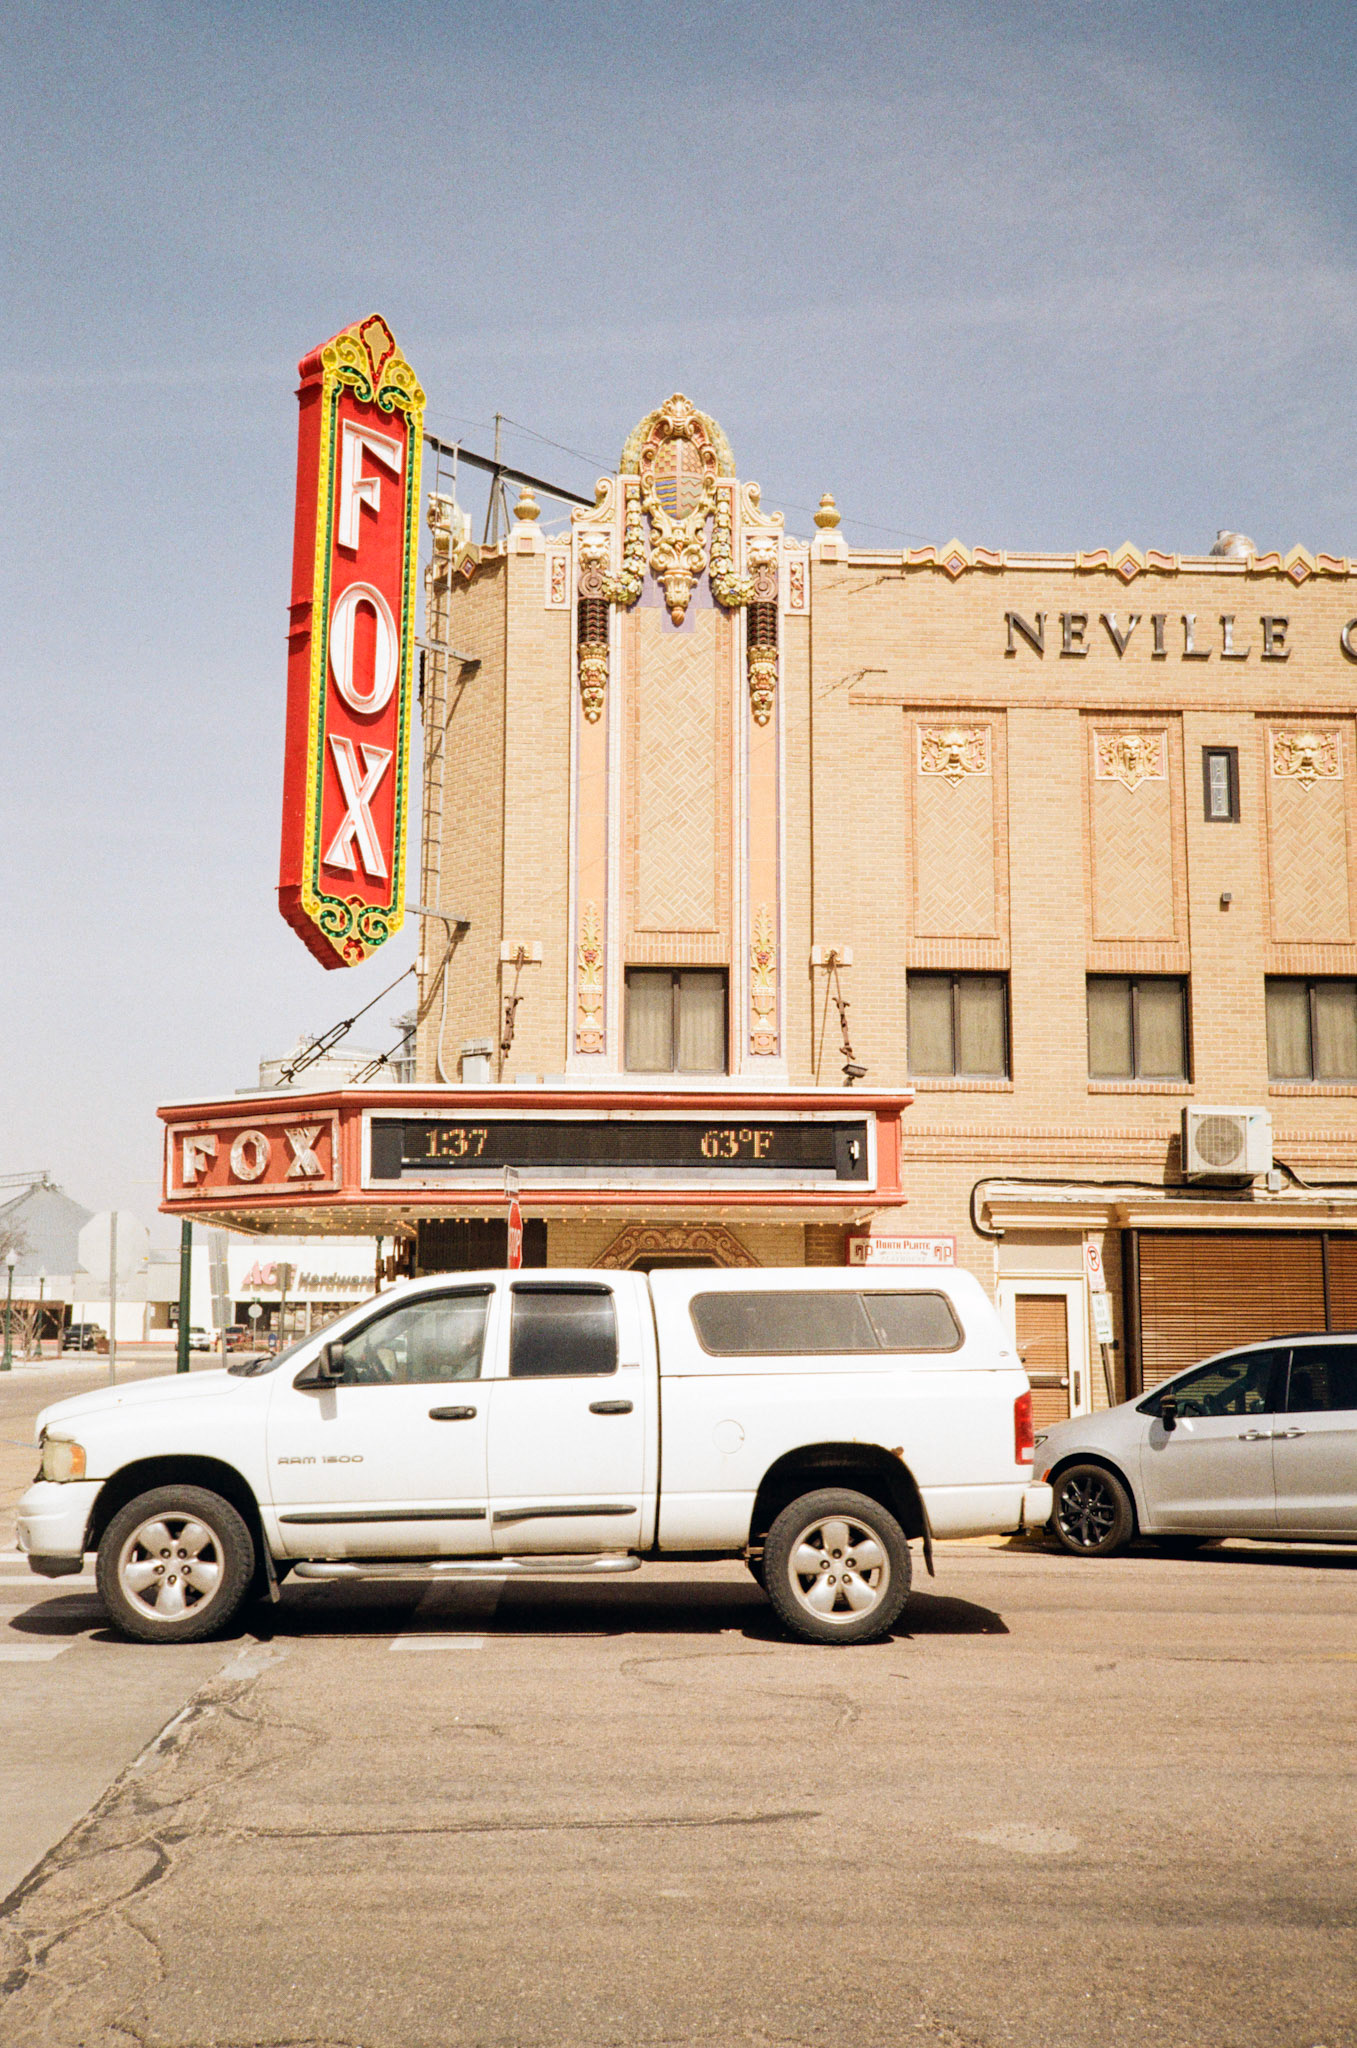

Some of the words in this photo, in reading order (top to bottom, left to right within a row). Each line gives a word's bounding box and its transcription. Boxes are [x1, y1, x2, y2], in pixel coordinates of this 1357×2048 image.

[323, 418, 401, 878] FOX
[1003, 611, 1292, 661] NEVILLE
[183, 1125, 326, 1184] FOX
[425, 1128, 488, 1157] 1:37
[299, 1272, 376, 1286] Hardware
[278, 1456, 316, 1465] RAM
